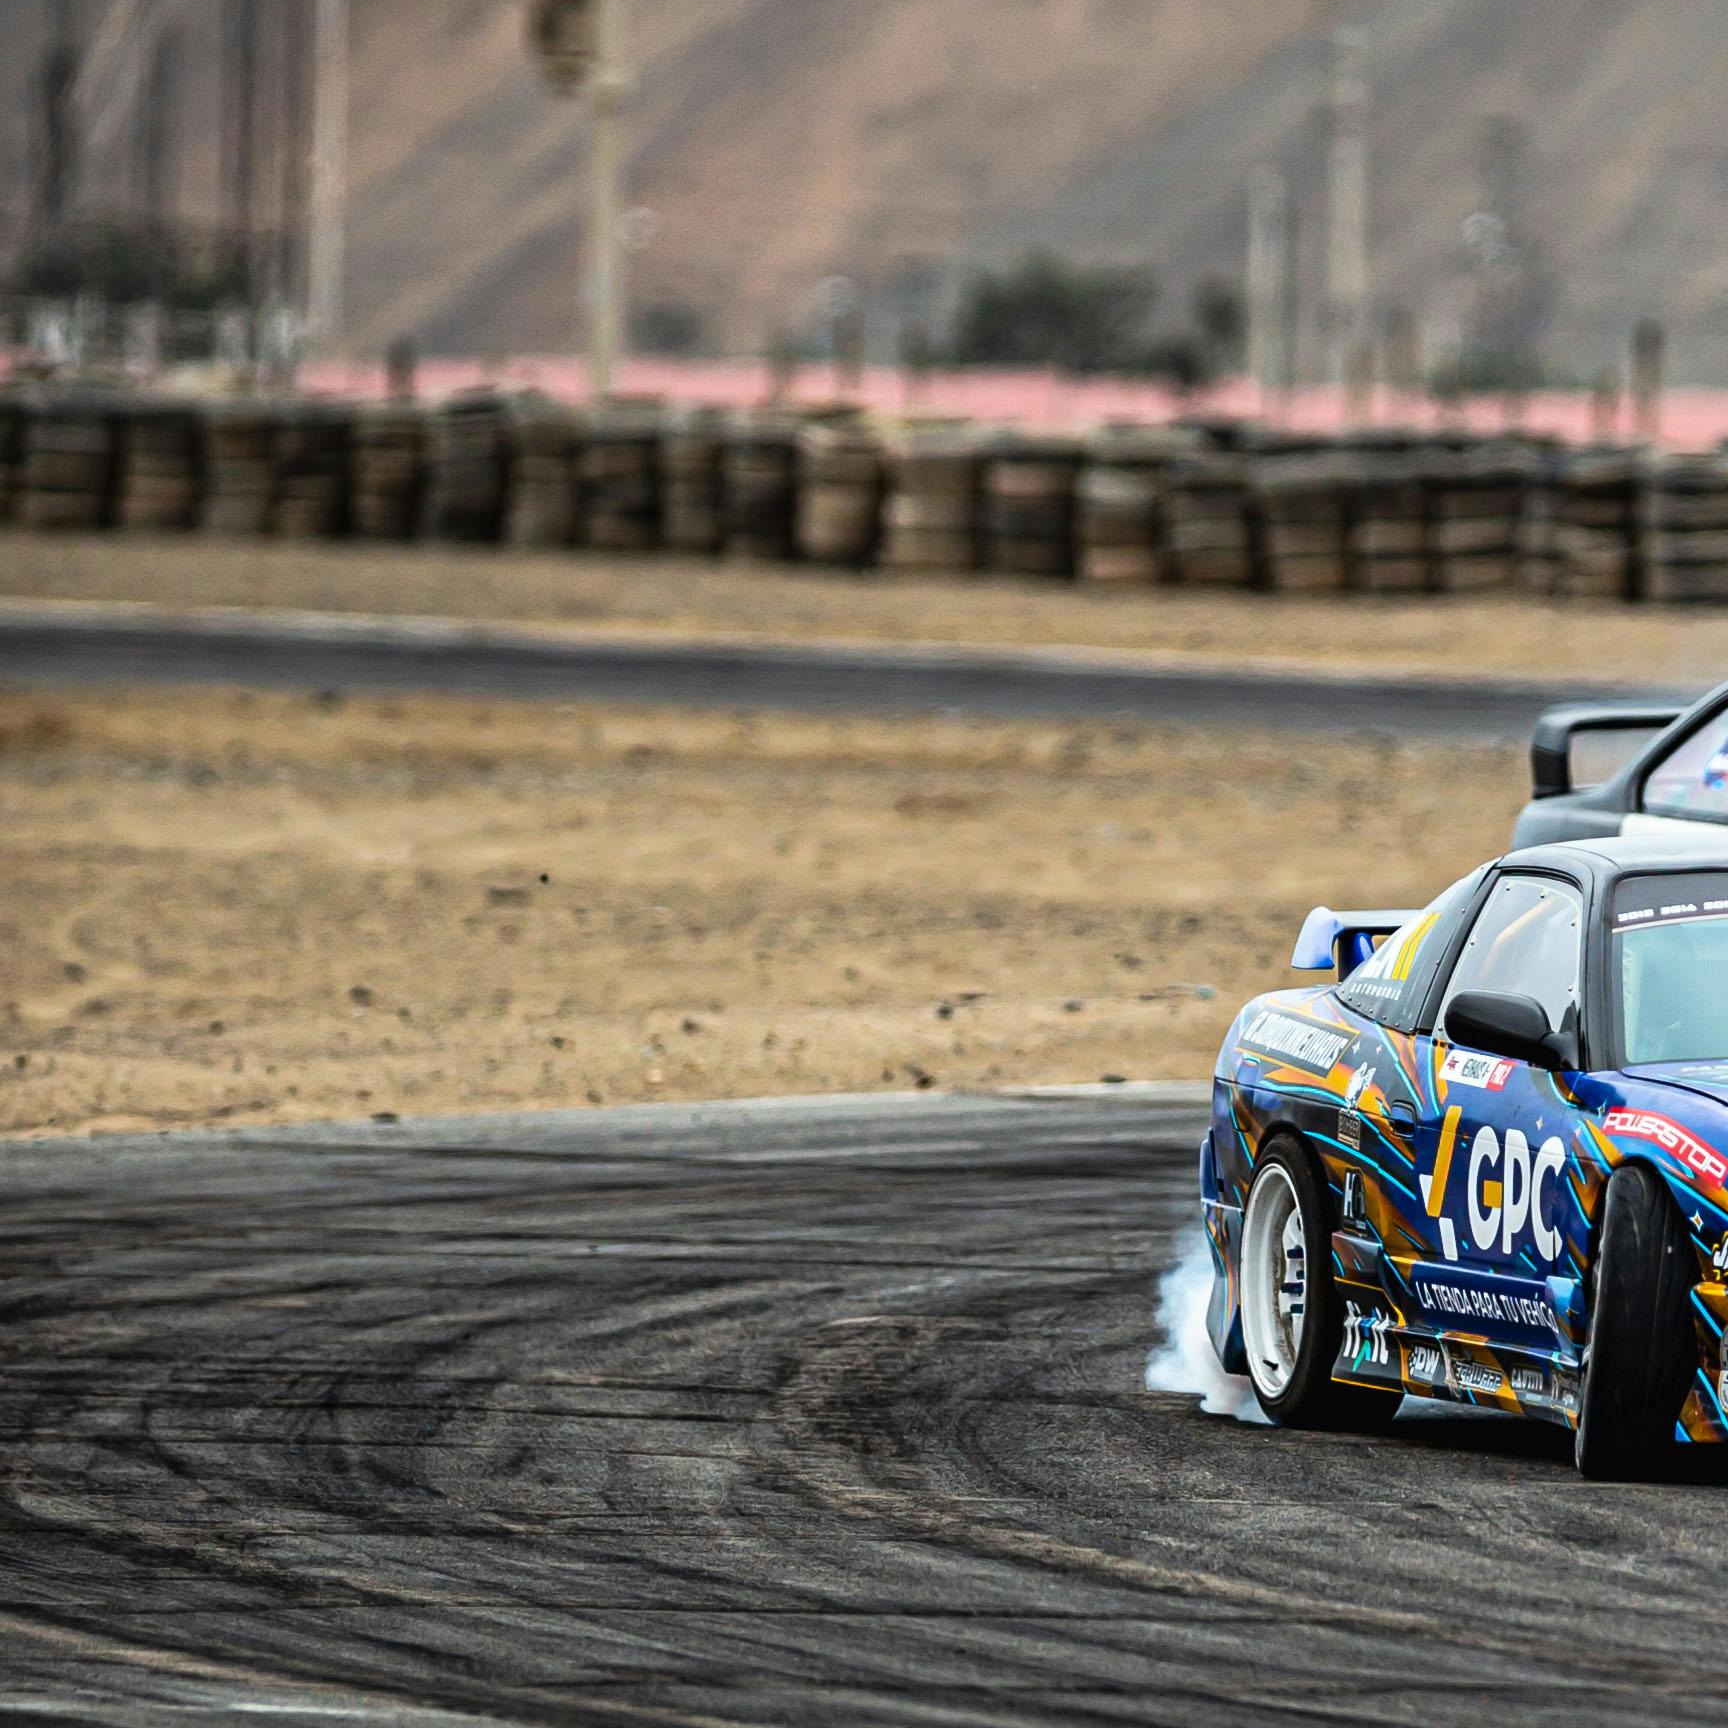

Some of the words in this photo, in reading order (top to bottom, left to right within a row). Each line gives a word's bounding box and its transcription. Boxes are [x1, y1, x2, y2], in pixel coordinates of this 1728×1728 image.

[1468, 1125, 1566, 1261] GPC
[1415, 1281, 1437, 1310] LA
[1431, 1283, 1476, 1316] TIENDA
[1470, 1290, 1506, 1321] PARA
[1500, 1294, 1519, 1324] TU
